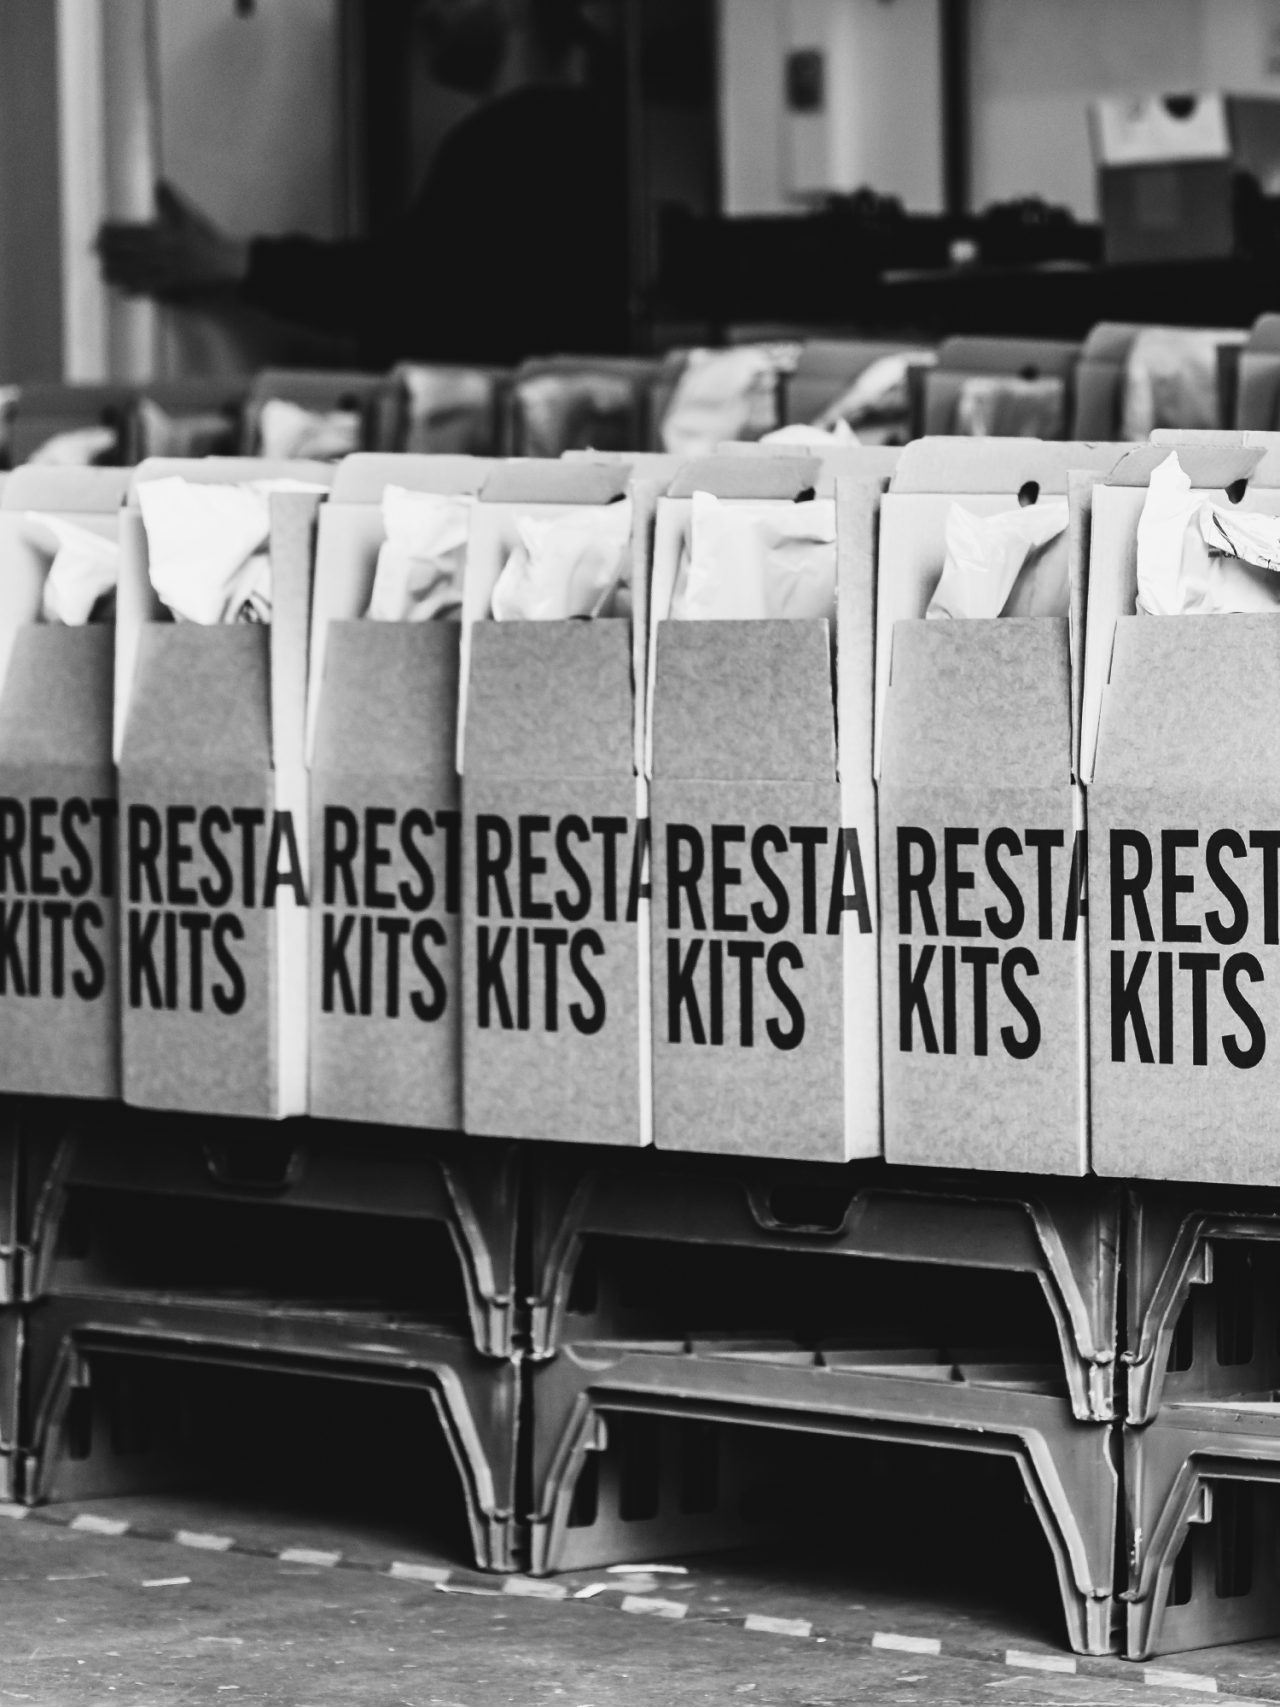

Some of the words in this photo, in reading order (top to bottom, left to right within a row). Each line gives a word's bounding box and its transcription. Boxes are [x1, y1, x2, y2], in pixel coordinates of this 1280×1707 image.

[0, 797, 118, 898] REST
[128, 803, 310, 909] RESTA
[324, 804, 461, 914] REST
[666, 822, 873, 935] RESTA
[0, 900, 104, 1001] KITS
[128, 909, 246, 1015] KITS
[321, 912, 448, 1022] KITS
[476, 924, 607, 1036] KITS
[667, 937, 806, 1051] KITS
[899, 943, 1041, 1060] KITS
[1109, 949, 1266, 1070] KITS
